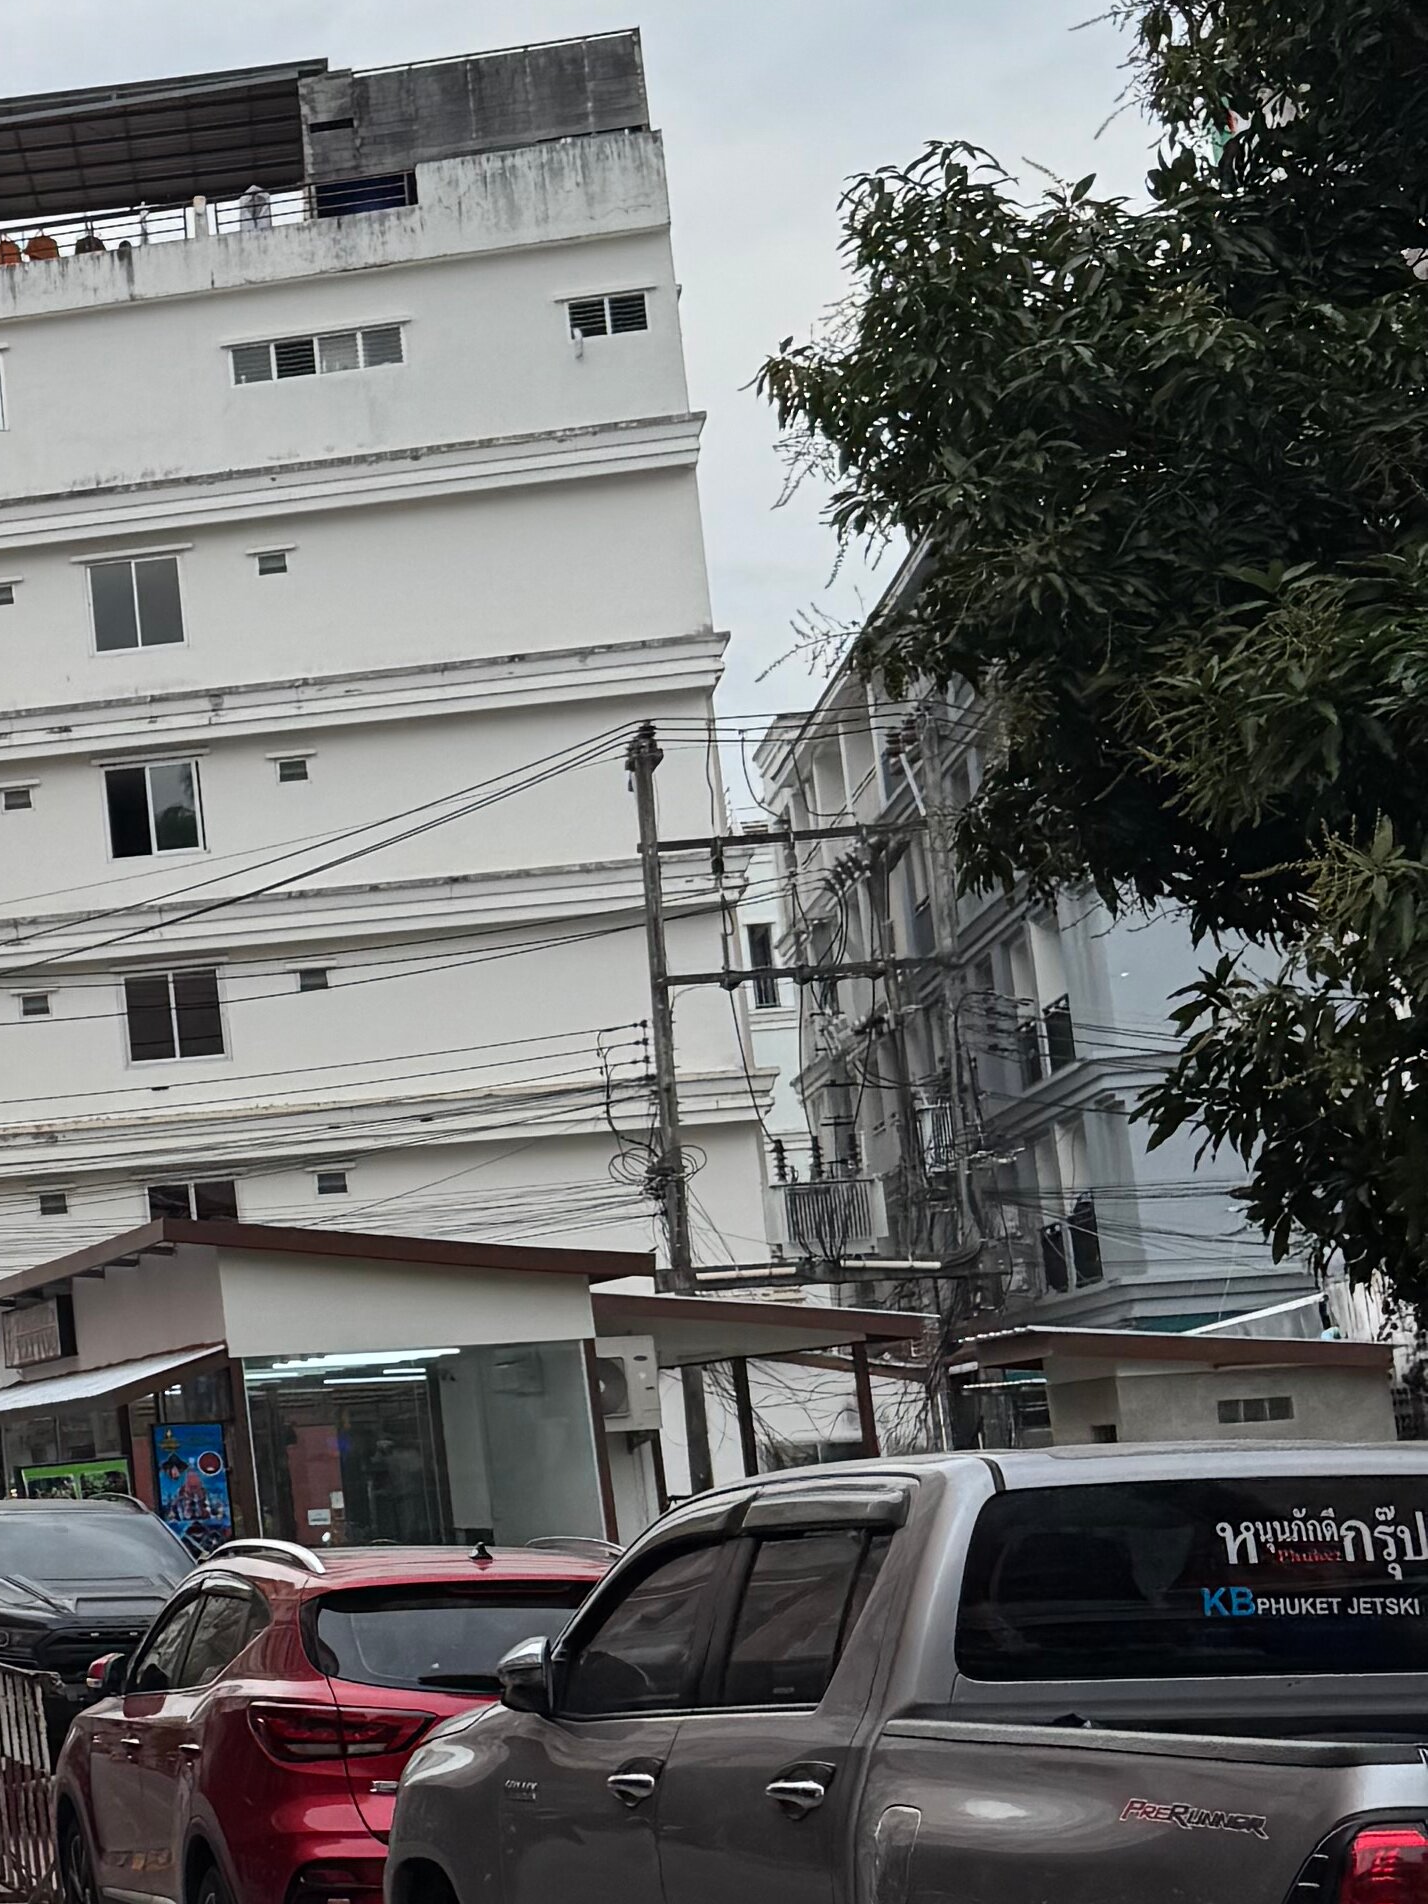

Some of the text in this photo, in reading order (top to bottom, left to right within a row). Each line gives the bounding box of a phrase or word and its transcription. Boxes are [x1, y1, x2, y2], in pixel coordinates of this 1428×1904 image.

[1202, 1586, 1421, 1617] KB PHUKET JETSKI
